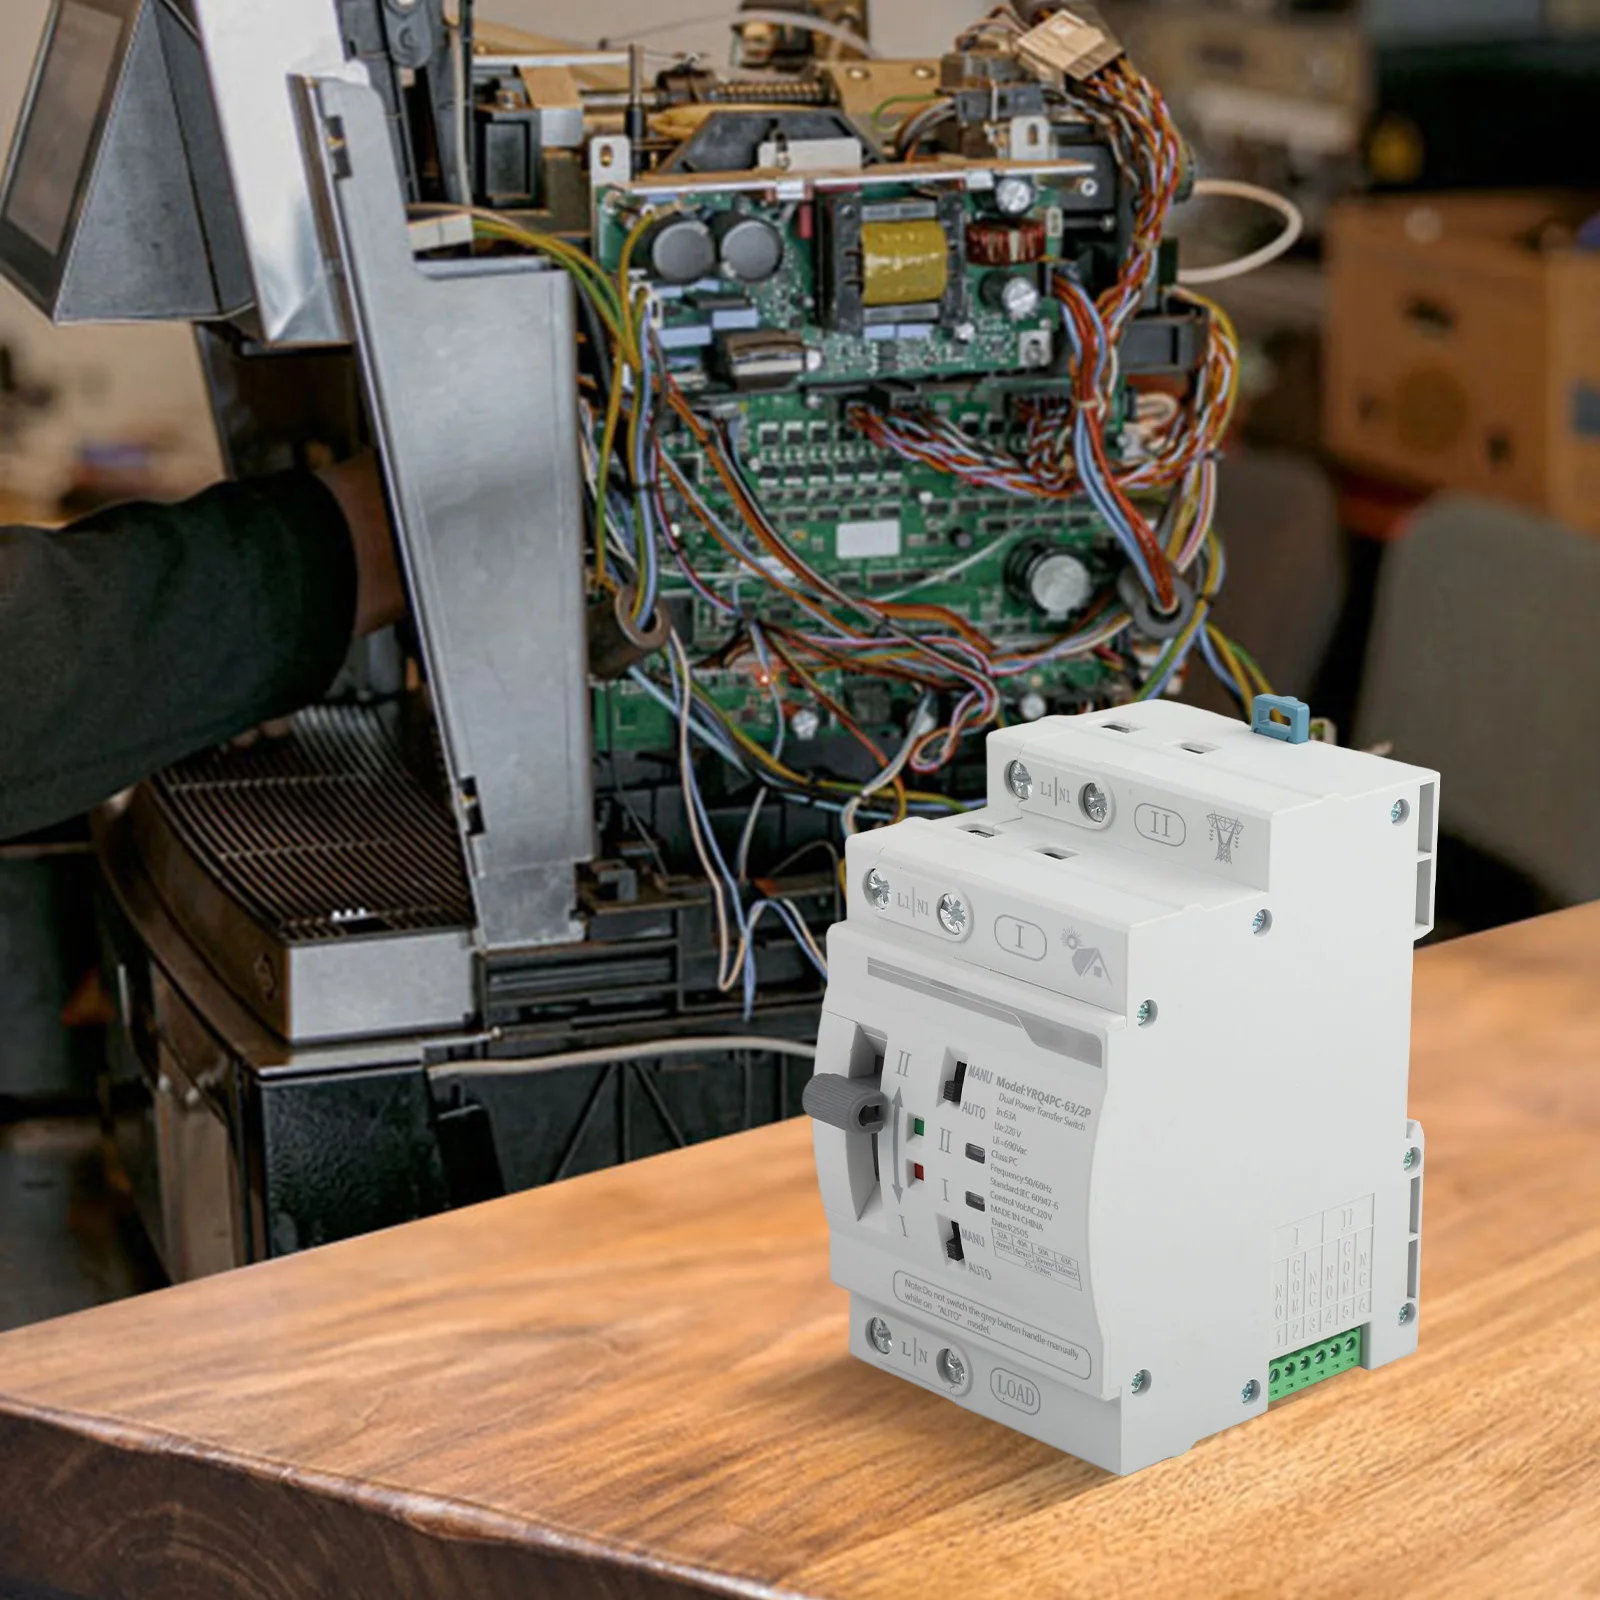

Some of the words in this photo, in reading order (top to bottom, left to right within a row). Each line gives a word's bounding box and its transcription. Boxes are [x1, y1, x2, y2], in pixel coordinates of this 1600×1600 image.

[1150, 810, 1171, 838] II
[968, 1064, 993, 1084] MANU
[961, 1100, 986, 1120] AUTO
[998, 1092, 1014, 1105] Dual
[1015, 1098, 1036, 1113] Power
[1037, 1106, 1063, 1123] Transfer
[1063, 1116, 1086, 1131] Switch
[990, 1204, 1011, 1219] MADE
[1012, 1213, 1020, 1222] IN
[1020, 1216, 1044, 1232] CHINA
[961, 1228, 985, 1248] MANU
[968, 1262, 992, 1281] AUTO
[904, 1292, 922, 1306] while
[922, 1300, 933, 1310] on
[934, 1290, 946, 1302] not
[946, 1295, 968, 1312] switch
[969, 1302, 980, 1316] the
[980, 1310, 997, 1326] grey
[997, 1315, 1021, 1334] button
[1022, 1325, 1046, 1345] handle
[1047, 1336, 1079, 1360] manually
[997, 1374, 1035, 1407] LOAD
